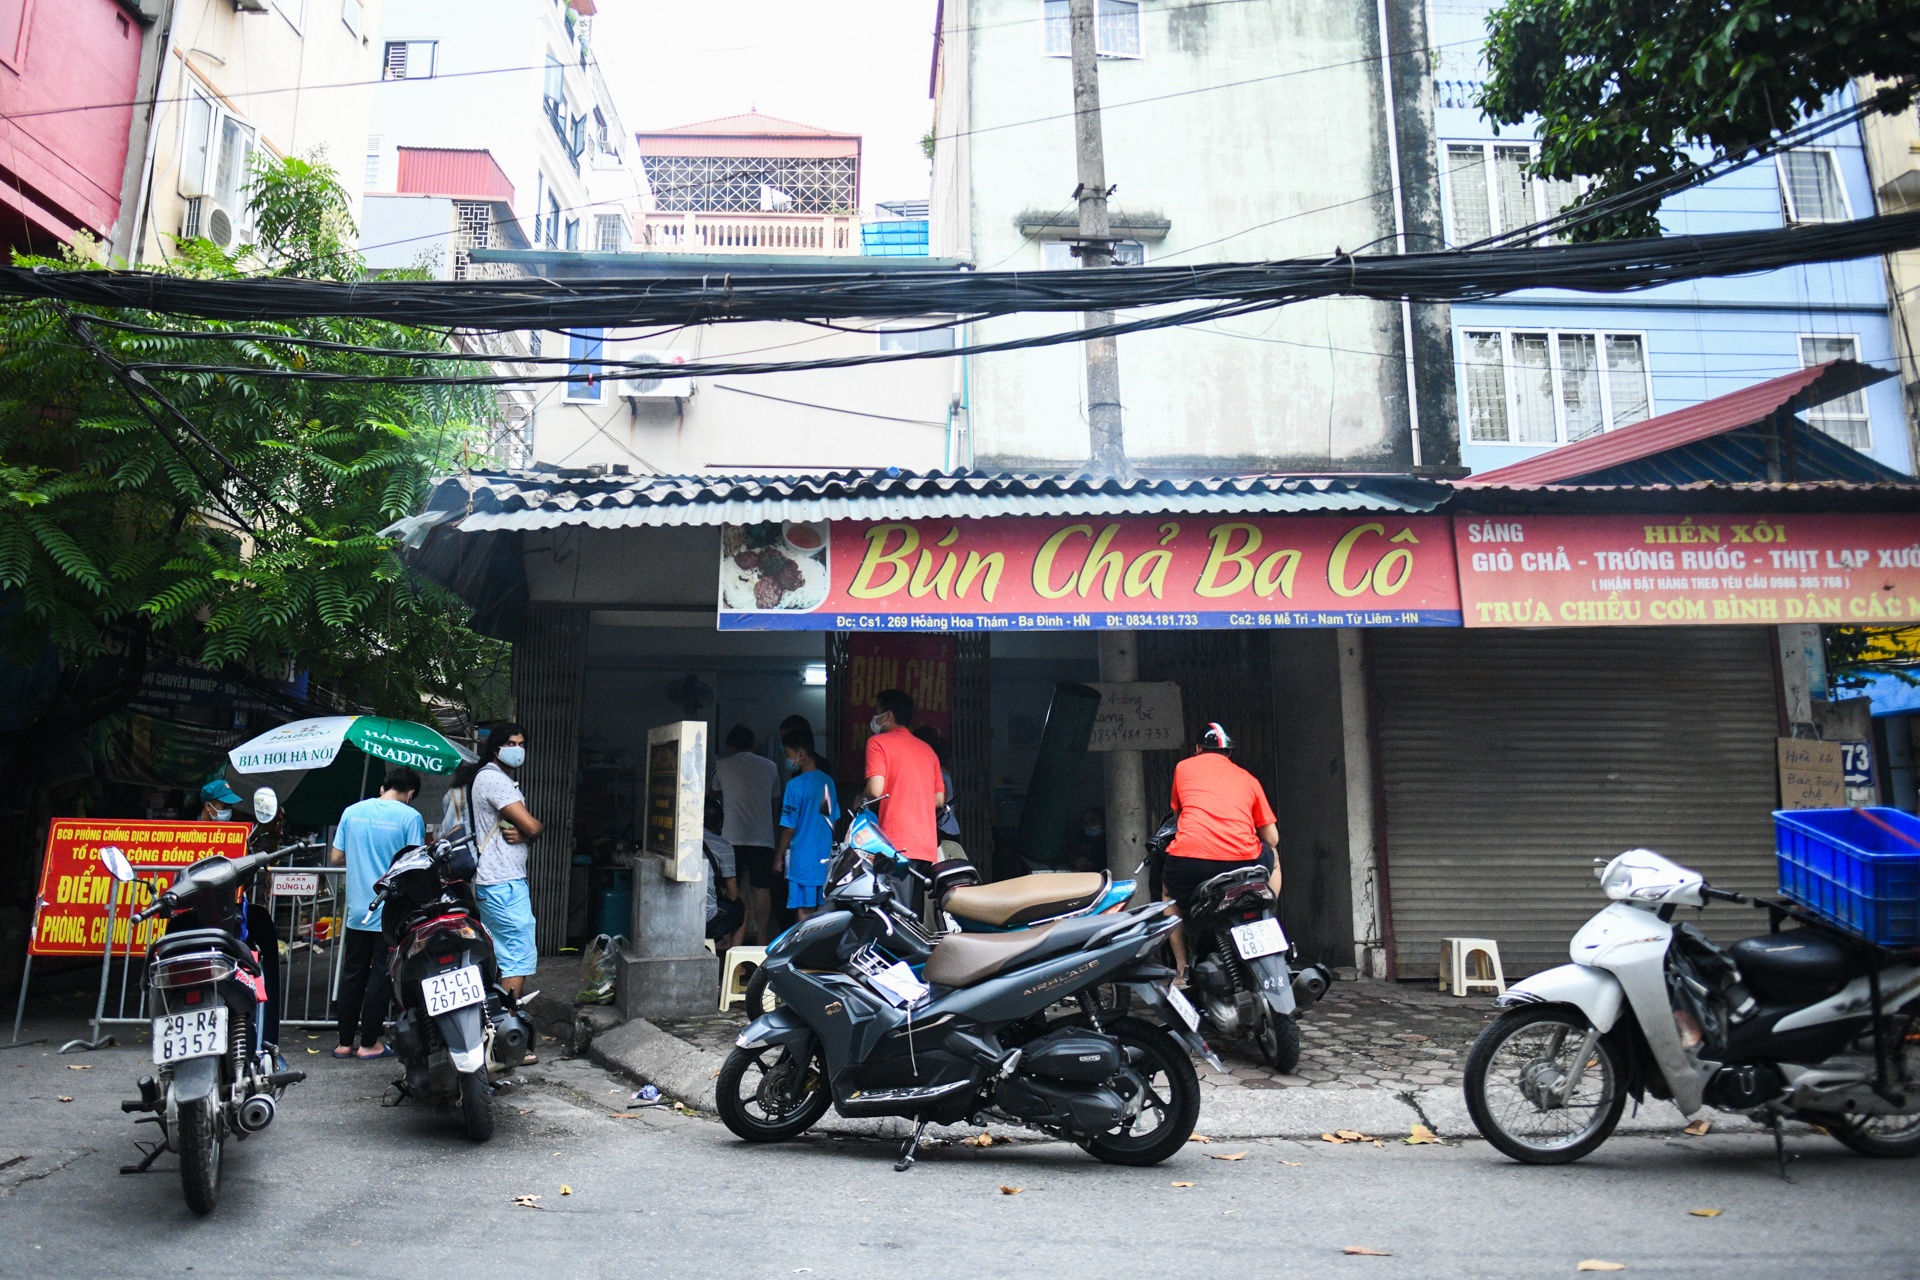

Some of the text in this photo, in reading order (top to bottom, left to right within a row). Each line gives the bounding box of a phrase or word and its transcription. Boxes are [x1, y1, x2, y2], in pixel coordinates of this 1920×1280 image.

[1468, 519, 1524, 543] SÁNG
[1643, 516, 1788, 544] HIỀN XÔI
[847, 521, 1421, 603] Bún Chả Ba Cô
[1471, 548, 1513, 572] GIÒ
[1521, 546, 1571, 572] CHẢ
[1593, 547, 1674, 571] TRỨNG
[1681, 544, 1746, 570] RUỐC
[1769, 549, 1819, 573] THỊT
[1599, 577, 1631, 592] NHẬN
[1633, 577, 1655, 592] ĐẶT
[1658, 575, 1689, 590] HÀNG
[1691, 577, 1719, 589] THEO
[1721, 575, 1742, 589] YÊU
[1229, 613, 1255, 626] Cs2:
[1257, 613, 1272, 626] 86
[1274, 611, 1291, 626] Mễ
[1293, 613, 1309, 625] Trì
[1318, 612, 1344, 625] Nam
[1346, 611, 1362, 625] Từ
[1364, 611, 1392, 624] Liêm
[1402, 611, 1419, 624] HN
[1475, 598, 1553, 622] TRƯA
[1559, 591, 1642, 621] CHIỀU
[1649, 596, 1706, 621] CƠM
[1712, 593, 1779, 619] BÌNH
[1786, 592, 1842, 619] DÂN
[1849, 592, 1902, 618] CÁC
[836, 615, 856, 628] Đc:
[859, 615, 885, 628] Cs1.
[887, 615, 908, 628] 269
[951, 615, 974, 628] Hoa
[976, 615, 1008, 628] Thám
[1018, 615, 1034, 627] Ba
[1036, 614, 1063, 627] Đình
[1073, 614, 1091, 627] HN
[1106, 614, 1199, 627] Đt: 0834.181.733
[239, 755, 260, 767] BIA
[291, 747, 307, 762] HÀ
[310, 745, 335, 762] NỘI
[361, 738, 443, 772] TRADING
[1841, 744, 1870, 771] 73
[56, 826, 244, 844] BCĐ PHÒNG CHỐNG DỊCH COVID PHƯỜNG LIỄU GIAI
[72, 843, 89, 860] TỔ
[126, 846, 160, 864] CỘNG
[161, 846, 195, 862] ĐỒNG
[56, 865, 111, 904] ĐIỂM
[300, 884, 315, 892] LẠI
[40, 909, 87, 946] PHÒNG,
[431, 971, 471, 995] 21-C1
[430, 984, 480, 1012] 267.50
[163, 1010, 218, 1037] 29-R4
[163, 1031, 218, 1060] 8352
